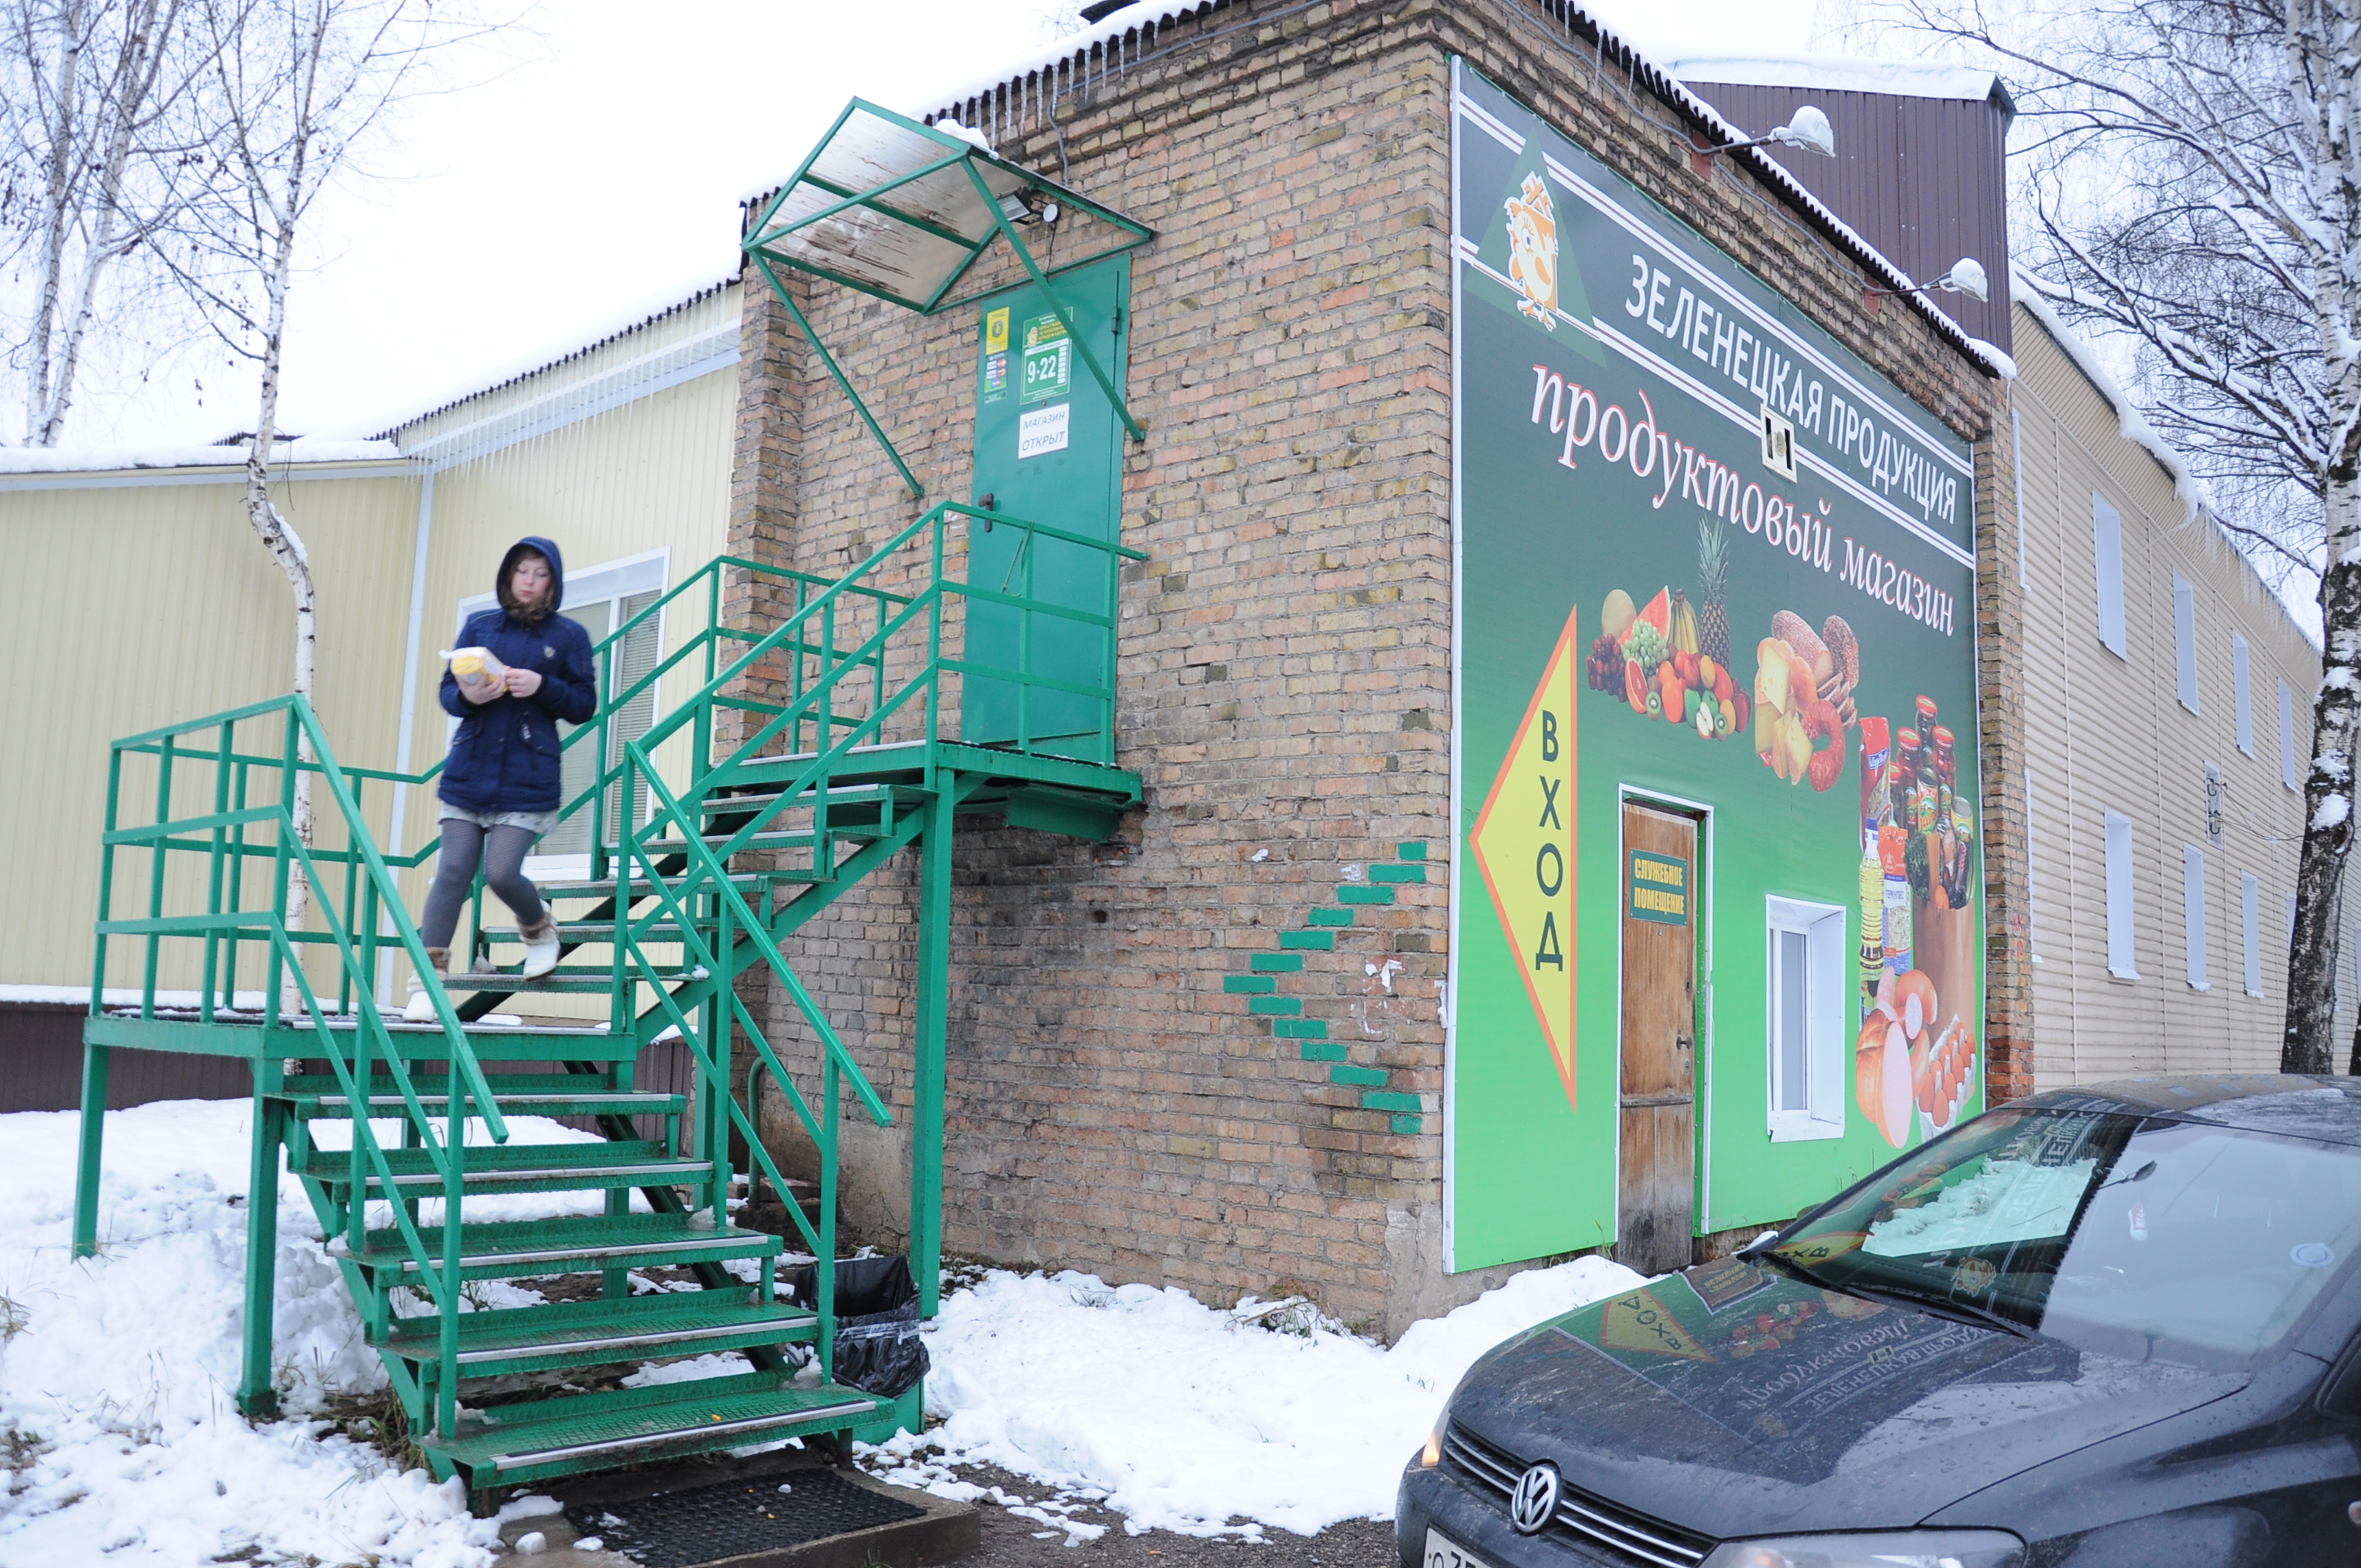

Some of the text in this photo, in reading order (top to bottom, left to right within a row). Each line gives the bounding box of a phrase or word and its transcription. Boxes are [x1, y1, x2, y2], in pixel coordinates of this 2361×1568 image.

[1625, 254, 1957, 525] ЗЕЛЕНЕЦКАЯ ПРОДУКЦИЯ
[1023, 412, 1065, 429] МАГАЗИН
[1021, 432, 1066, 451] ОТКРЫТ
[1531, 363, 1955, 637] продуктовый магазин
[1534, 709, 1564, 973] ВХОД
[1634, 857, 1683, 887] СЛУЖЕБНОЕ
[1634, 887, 1685, 915] ПОМЕЩЕНИЕ
